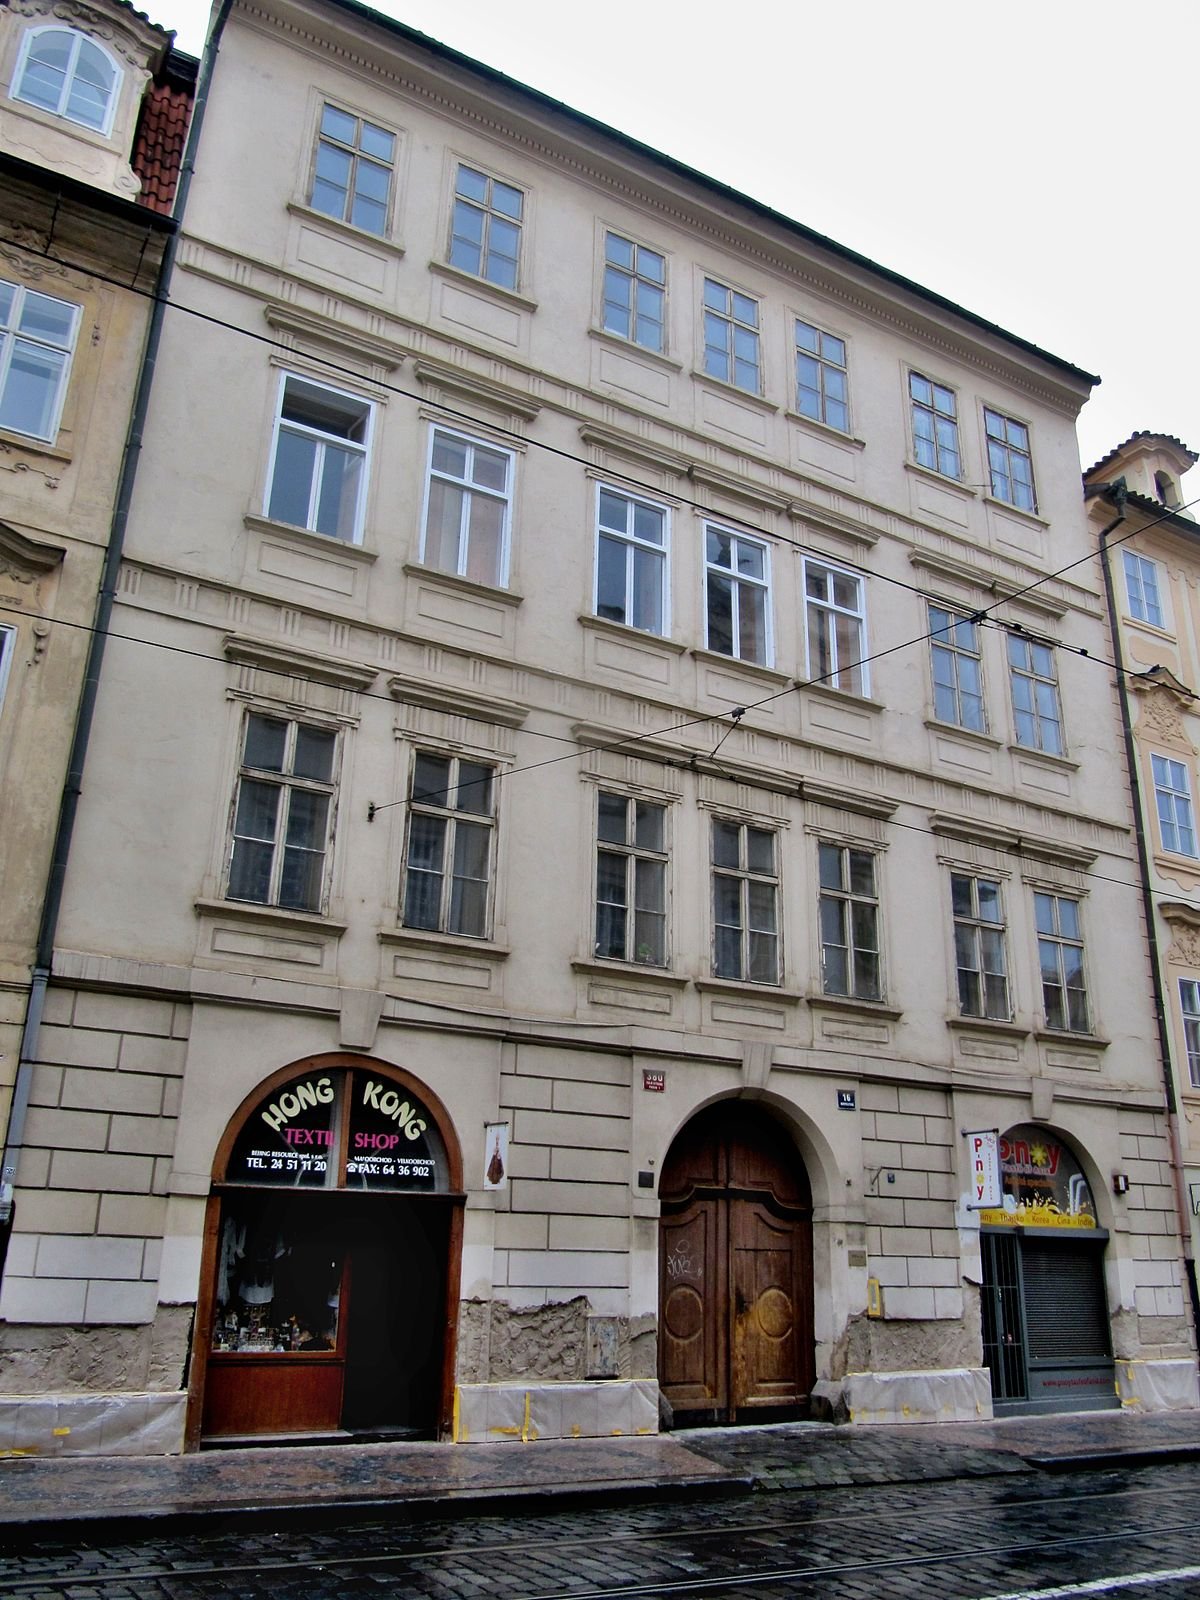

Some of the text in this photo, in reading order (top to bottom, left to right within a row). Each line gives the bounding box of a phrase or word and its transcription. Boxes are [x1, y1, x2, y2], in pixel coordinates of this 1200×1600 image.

[842, 1093, 851, 1102] 16
[261, 1077, 427, 1141] HONG KONG
[284, 1128, 400, 1150] TEXTIL SHOP
[271, 1151, 298, 1159] RESOURCE
[246, 1157, 327, 1171] TEL. 24 51 11 20
[358, 1163, 430, 1177] FAX: 64 36 902
[1032, 1214, 1050, 1224] Korea
